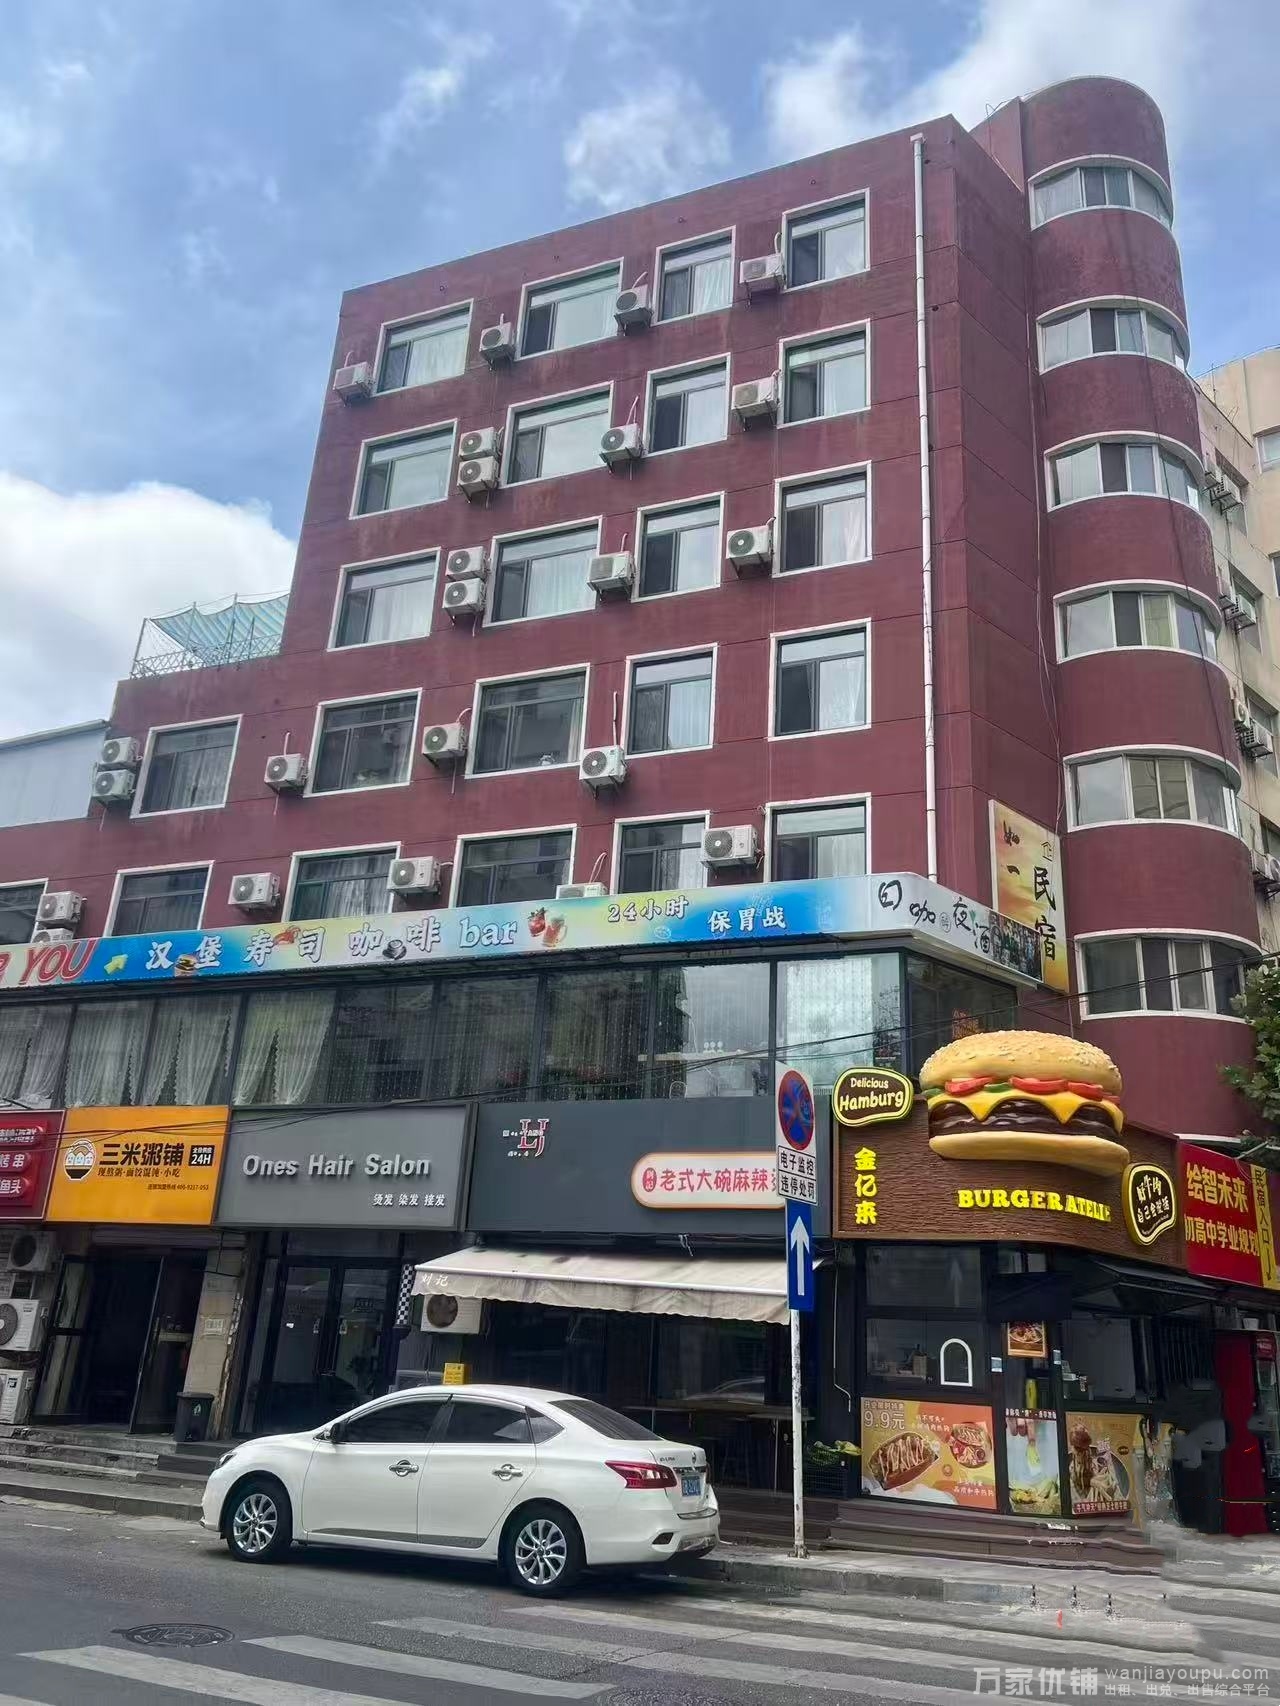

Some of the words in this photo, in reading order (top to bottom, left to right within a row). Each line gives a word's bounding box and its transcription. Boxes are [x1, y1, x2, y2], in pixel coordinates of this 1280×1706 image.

[608, 895, 690, 923] 24小时
[707, 906, 787, 933] 保胃战
[459, 916, 517, 949] bar
[19, 937, 98, 986] YOU
[850, 1077, 889, 1089] Delicious
[840, 1090, 904, 1112] Hamburg
[99, 1142, 185, 1167] 三米粥铺
[191, 1153, 212, 1165] 24H
[242, 1154, 298, 1176] Ones
[307, 1154, 354, 1176] Hair
[364, 1153, 431, 1176] Salon
[780, 1151, 815, 1176] 电子监控
[660, 1168, 777, 1193] 老式大碗麻辣
[780, 1175, 816, 1200] 违停处罚
[1186, 1162, 1248, 1213] 绘智未来
[372, 1193, 393, 1206] 烫发
[398, 1193, 419, 1206] 染发
[424, 1194, 445, 1206] 接发
[957, 1189, 1064, 1211] BURGER
[864, 1410, 905, 1430] 9.9元
